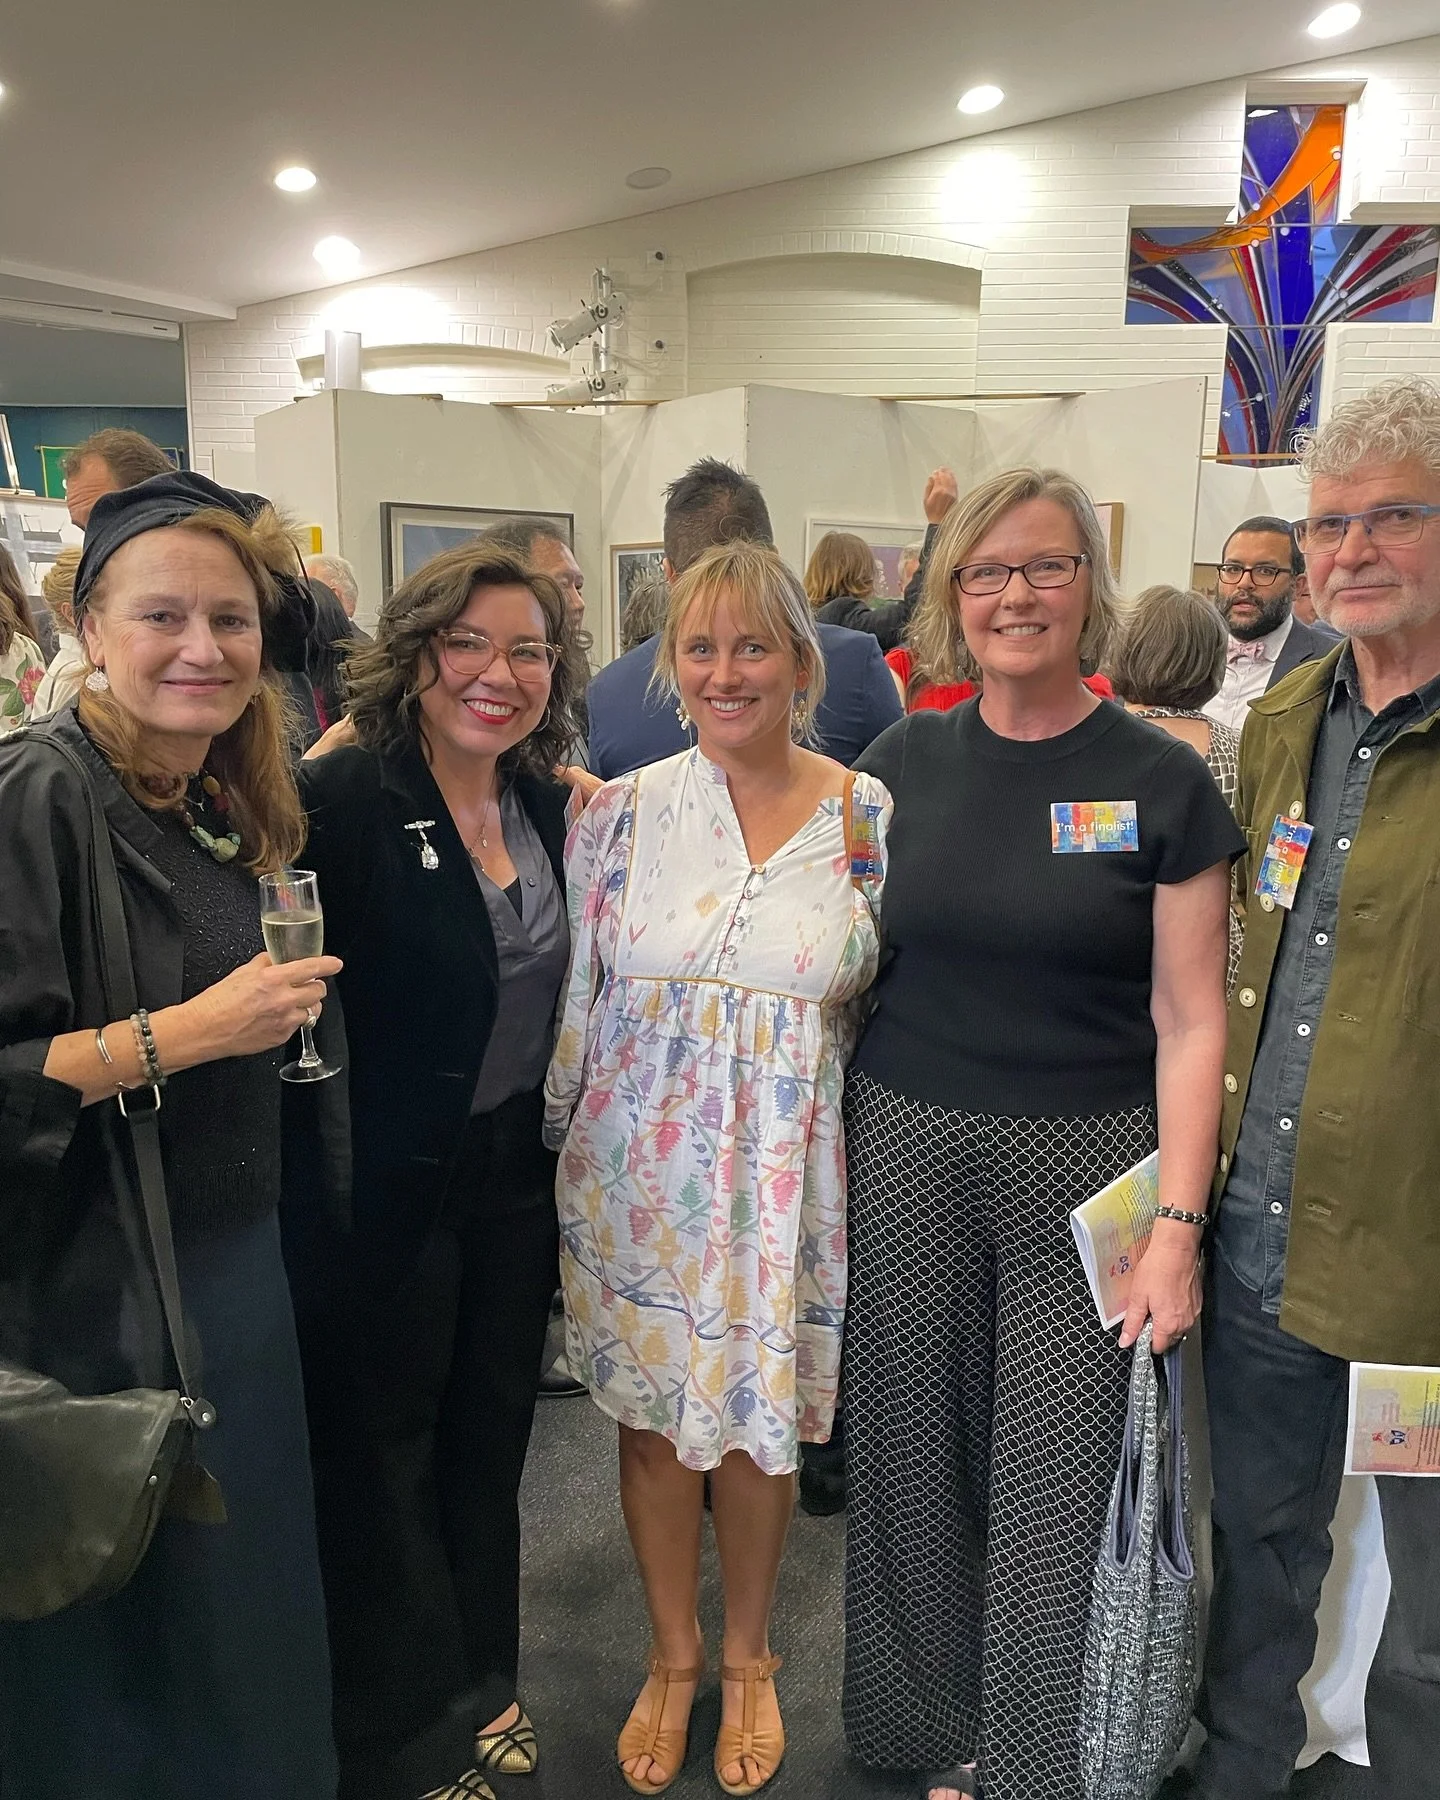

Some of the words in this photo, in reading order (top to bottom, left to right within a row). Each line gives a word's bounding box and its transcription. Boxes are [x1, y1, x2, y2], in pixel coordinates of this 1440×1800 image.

[1055, 822, 1076, 833] I'm
[1090, 820, 1134, 832] finalist!
[1285, 824, 1298, 843] I'm
[868, 848, 874, 856] a
[1282, 846, 1289, 854] a
[866, 858, 874, 876] I'm
[1271, 857, 1288, 900] finalist!
